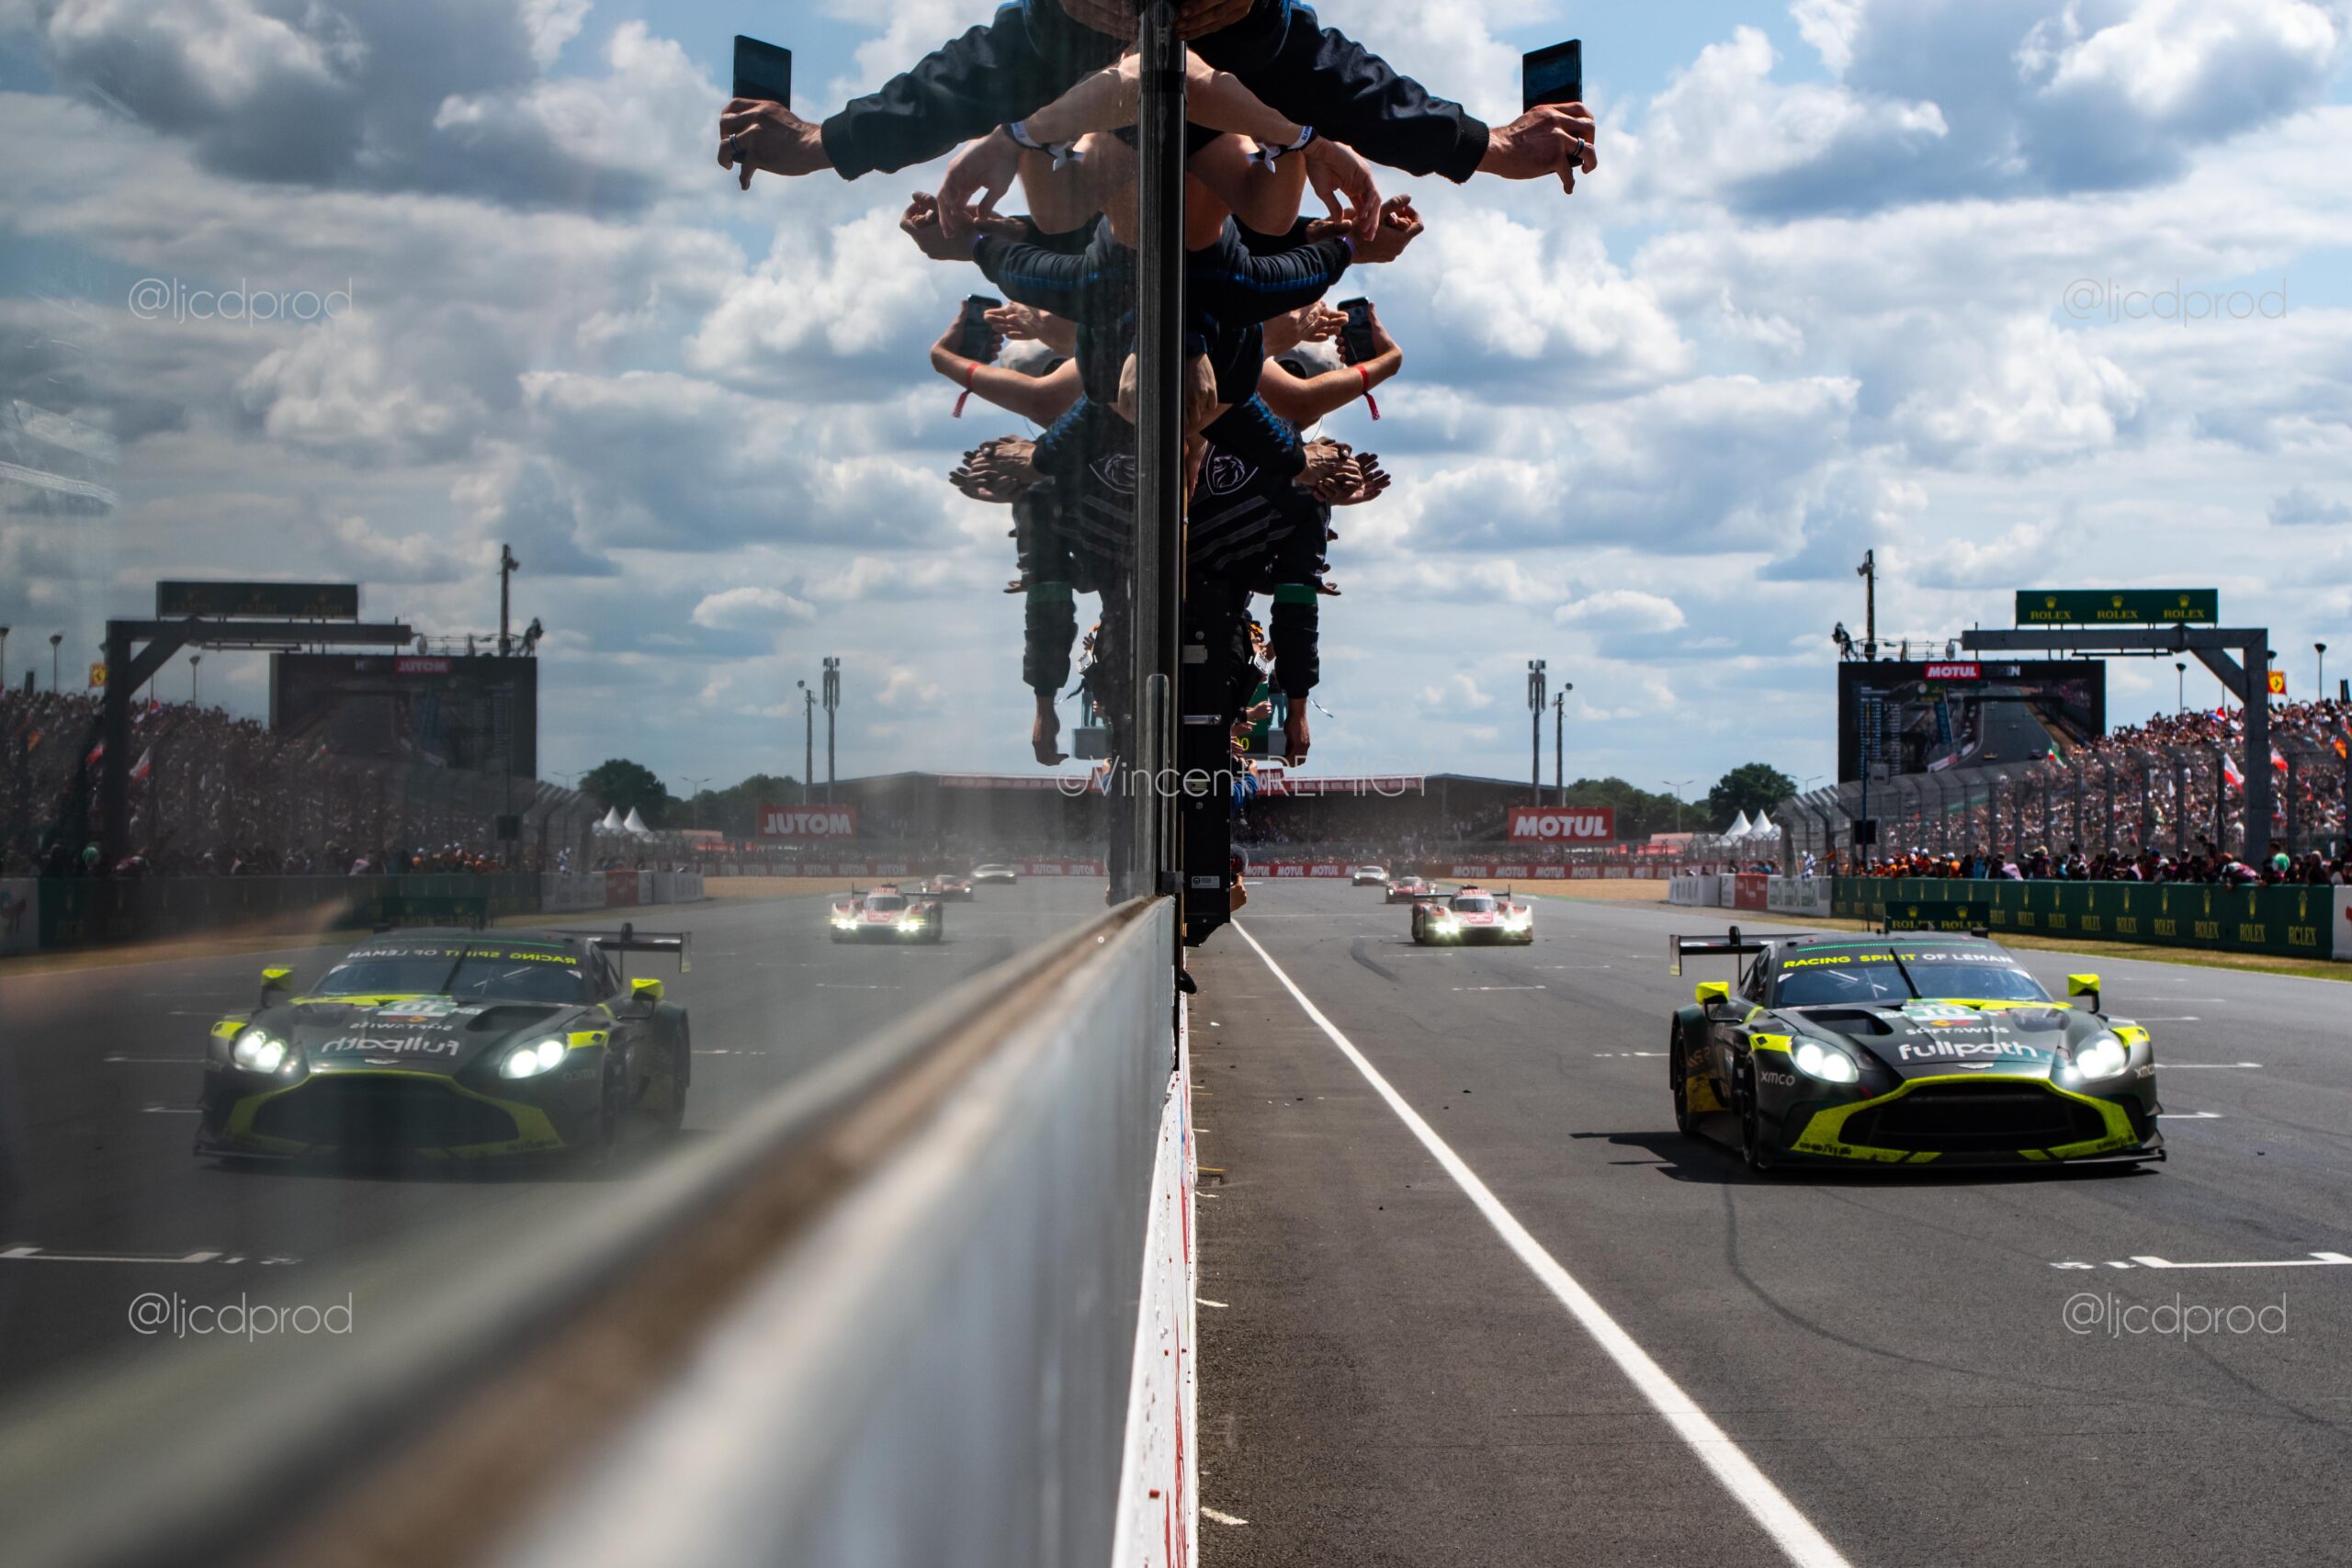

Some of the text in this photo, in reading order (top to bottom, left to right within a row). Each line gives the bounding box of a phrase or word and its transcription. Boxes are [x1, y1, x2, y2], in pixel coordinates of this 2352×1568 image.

[2030, 609, 2204, 620] ROLEX ROLEX ROLEX
[1928, 666, 1977, 678] MOTUL
[1513, 816, 1608, 837] MOTUL
[1277, 866, 1304, 876] MOTUL
[1310, 865, 1339, 875] MOTUL
[1453, 866, 1487, 877] MOTUL
[1495, 866, 1528, 877] MOTUL
[1534, 866, 1566, 878] MOTUL
[2195, 920, 2220, 939] ROLEX
[2240, 923, 2266, 942] ROLEX
[1783, 956, 1851, 968] RACING
[1951, 953, 2014, 964] LEMAN
[1898, 1040, 2039, 1060] fullpath
[1760, 1071, 1795, 1087] xmco
